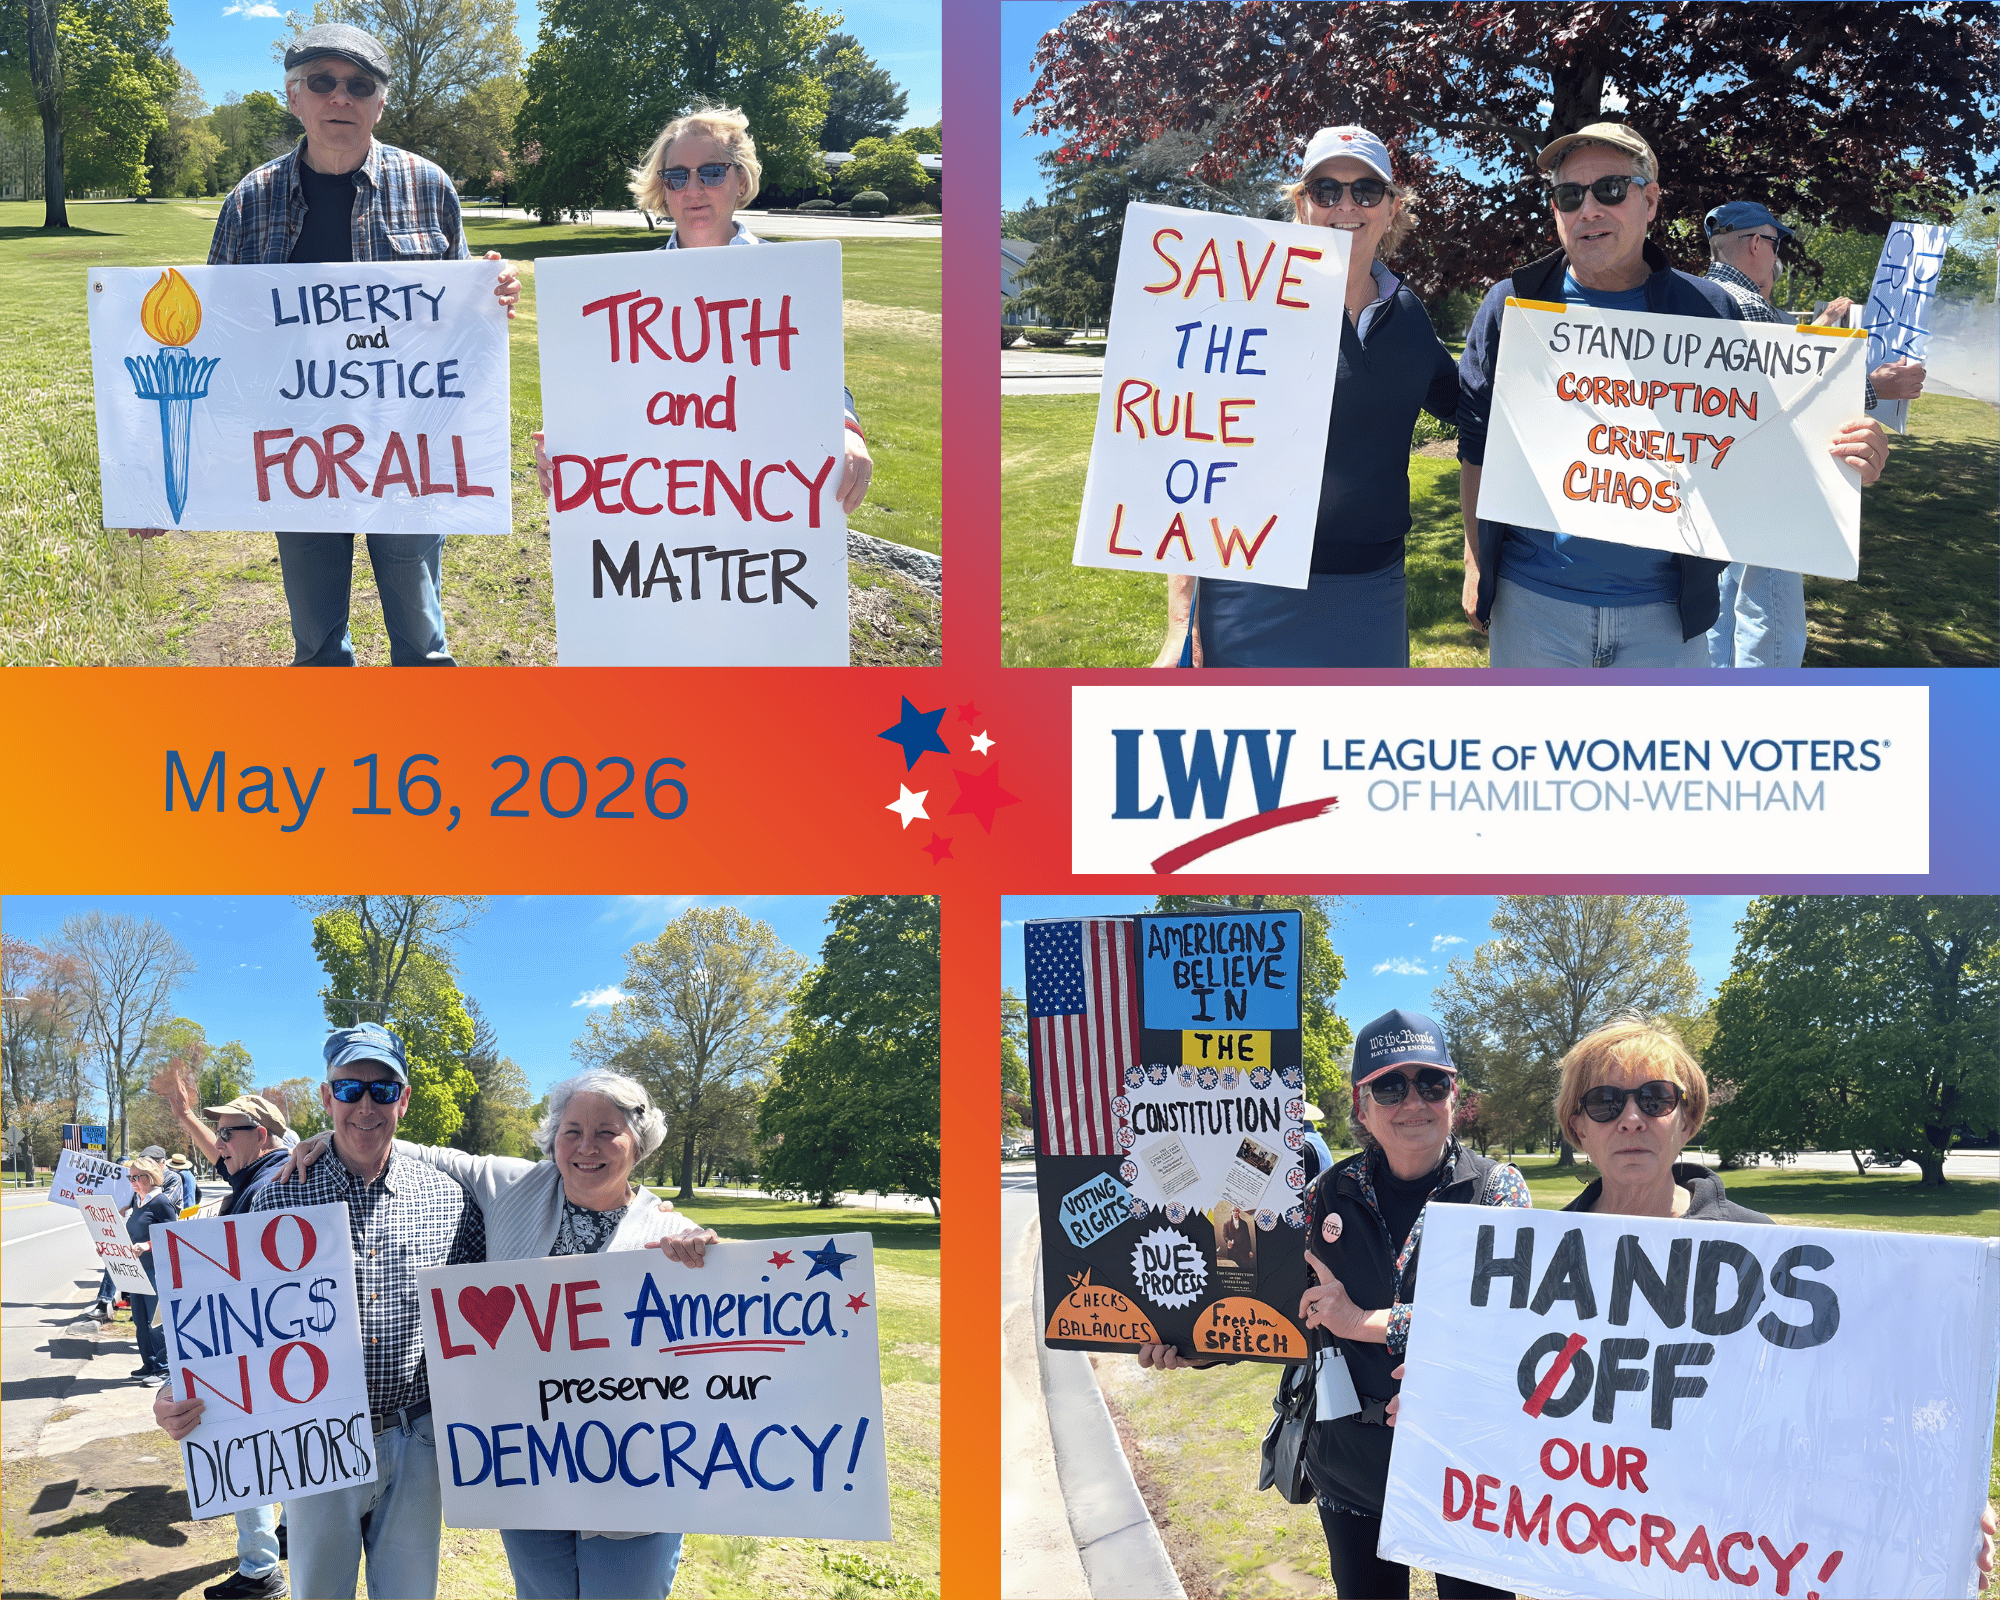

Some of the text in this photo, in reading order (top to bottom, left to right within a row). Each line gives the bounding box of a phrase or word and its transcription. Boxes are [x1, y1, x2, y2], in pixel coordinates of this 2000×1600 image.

[1143, 227, 1324, 310] SAVE
[272, 283, 446, 326] LIBERTY
[346, 325, 390, 351] and
[583, 289, 799, 372] TRUTH
[1175, 321, 1268, 376] THE
[1549, 321, 1837, 378] STAND UP AGAINST
[280, 358, 466, 401] JUSTICE
[1556, 372, 1758, 421] CORRUPTION
[648, 375, 738, 433] and
[1114, 378, 1256, 447] RULE
[253, 424, 494, 502] FOR ALL
[1587, 423, 1735, 471] CRUELTY
[551, 454, 836, 529] DECENCY
[1165, 458, 1238, 504] OF
[1562, 460, 1682, 514] CHAOS
[1107, 503, 1278, 570] LAW
[592, 538, 819, 610] MATTER
[1148, 921, 1287, 960] AMERICANS
[1173, 954, 1286, 989] BELIEVE
[1191, 989, 1247, 1022] IN
[1194, 1033, 1254, 1061] THE
[1369, 1029, 1434, 1050] We the People
[1370, 1048, 1389, 1058] HAVE
[1407, 1044, 1437, 1052] ENOUGH
[1132, 1097, 1280, 1135] CONSTITUTION
[68, 1154, 122, 1180] HANDS
[77, 1187, 93, 1195] OUR
[1064, 1178, 1117, 1216] VOTING
[85, 1205, 117, 1225] TRUTH
[102, 1225, 116, 1238] and
[1070, 1195, 1132, 1245] RIGHTS
[95, 1241, 136, 1261] DECENCY
[109, 1261, 144, 1279] MATTER
[165, 1214, 317, 1289] NO
[1141, 1244, 1194, 1272] DUE
[1070, 1293, 1128, 1312] CHECKS
[1141, 1273, 1203, 1296] PROCESS
[1470, 1224, 1841, 1350] HANDS
[1059, 1318, 1151, 1342] BALANCES
[1213, 1303, 1277, 1328] Freedom
[1235, 1327, 1249, 1336] of
[1205, 1330, 1287, 1353] SPEECH
[181, 1341, 329, 1415] NO
[539, 1374, 771, 1421] preserve our
[446, 1416, 870, 1492] DEMOCRACY!
[1540, 1437, 1649, 1494] OUR
[1442, 1466, 1844, 1600] DEMOCRACY!
